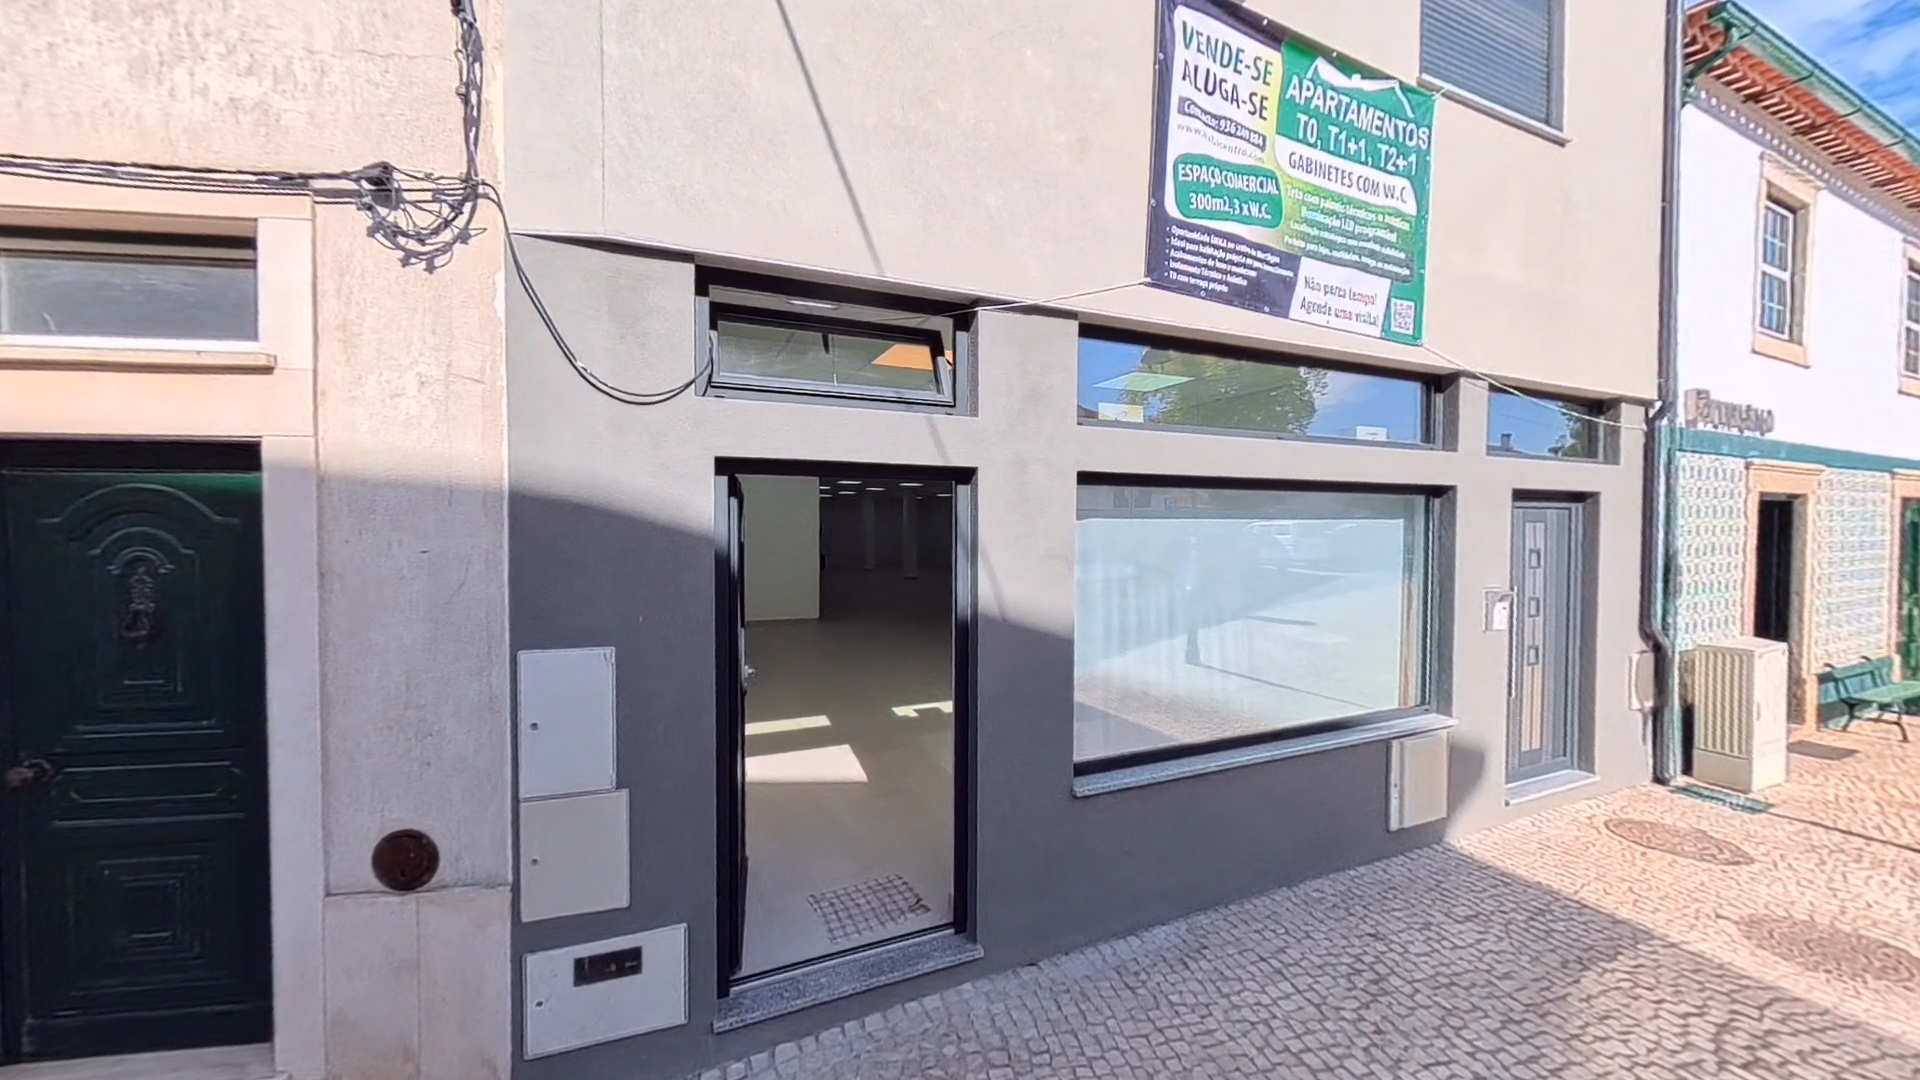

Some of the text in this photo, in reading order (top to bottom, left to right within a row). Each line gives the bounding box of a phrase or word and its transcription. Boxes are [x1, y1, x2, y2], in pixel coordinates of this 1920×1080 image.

[1182, 20, 1273, 87] VENDE-SE
[1182, 59, 1269, 121] ALUGA-SE
[1285, 74, 1430, 150] APARTAMENTOS
[1288, 151, 1353, 188] GABINETES
[1356, 175, 1380, 198] COM
[1297, 112, 1322, 149] T0,
[1328, 125, 1373, 167] T1+1,
[1377, 142, 1417, 176] T2+1
[1178, 163, 1279, 195] ESPAÇO COMERCIAL
[1304, 275, 1321, 292] Não
